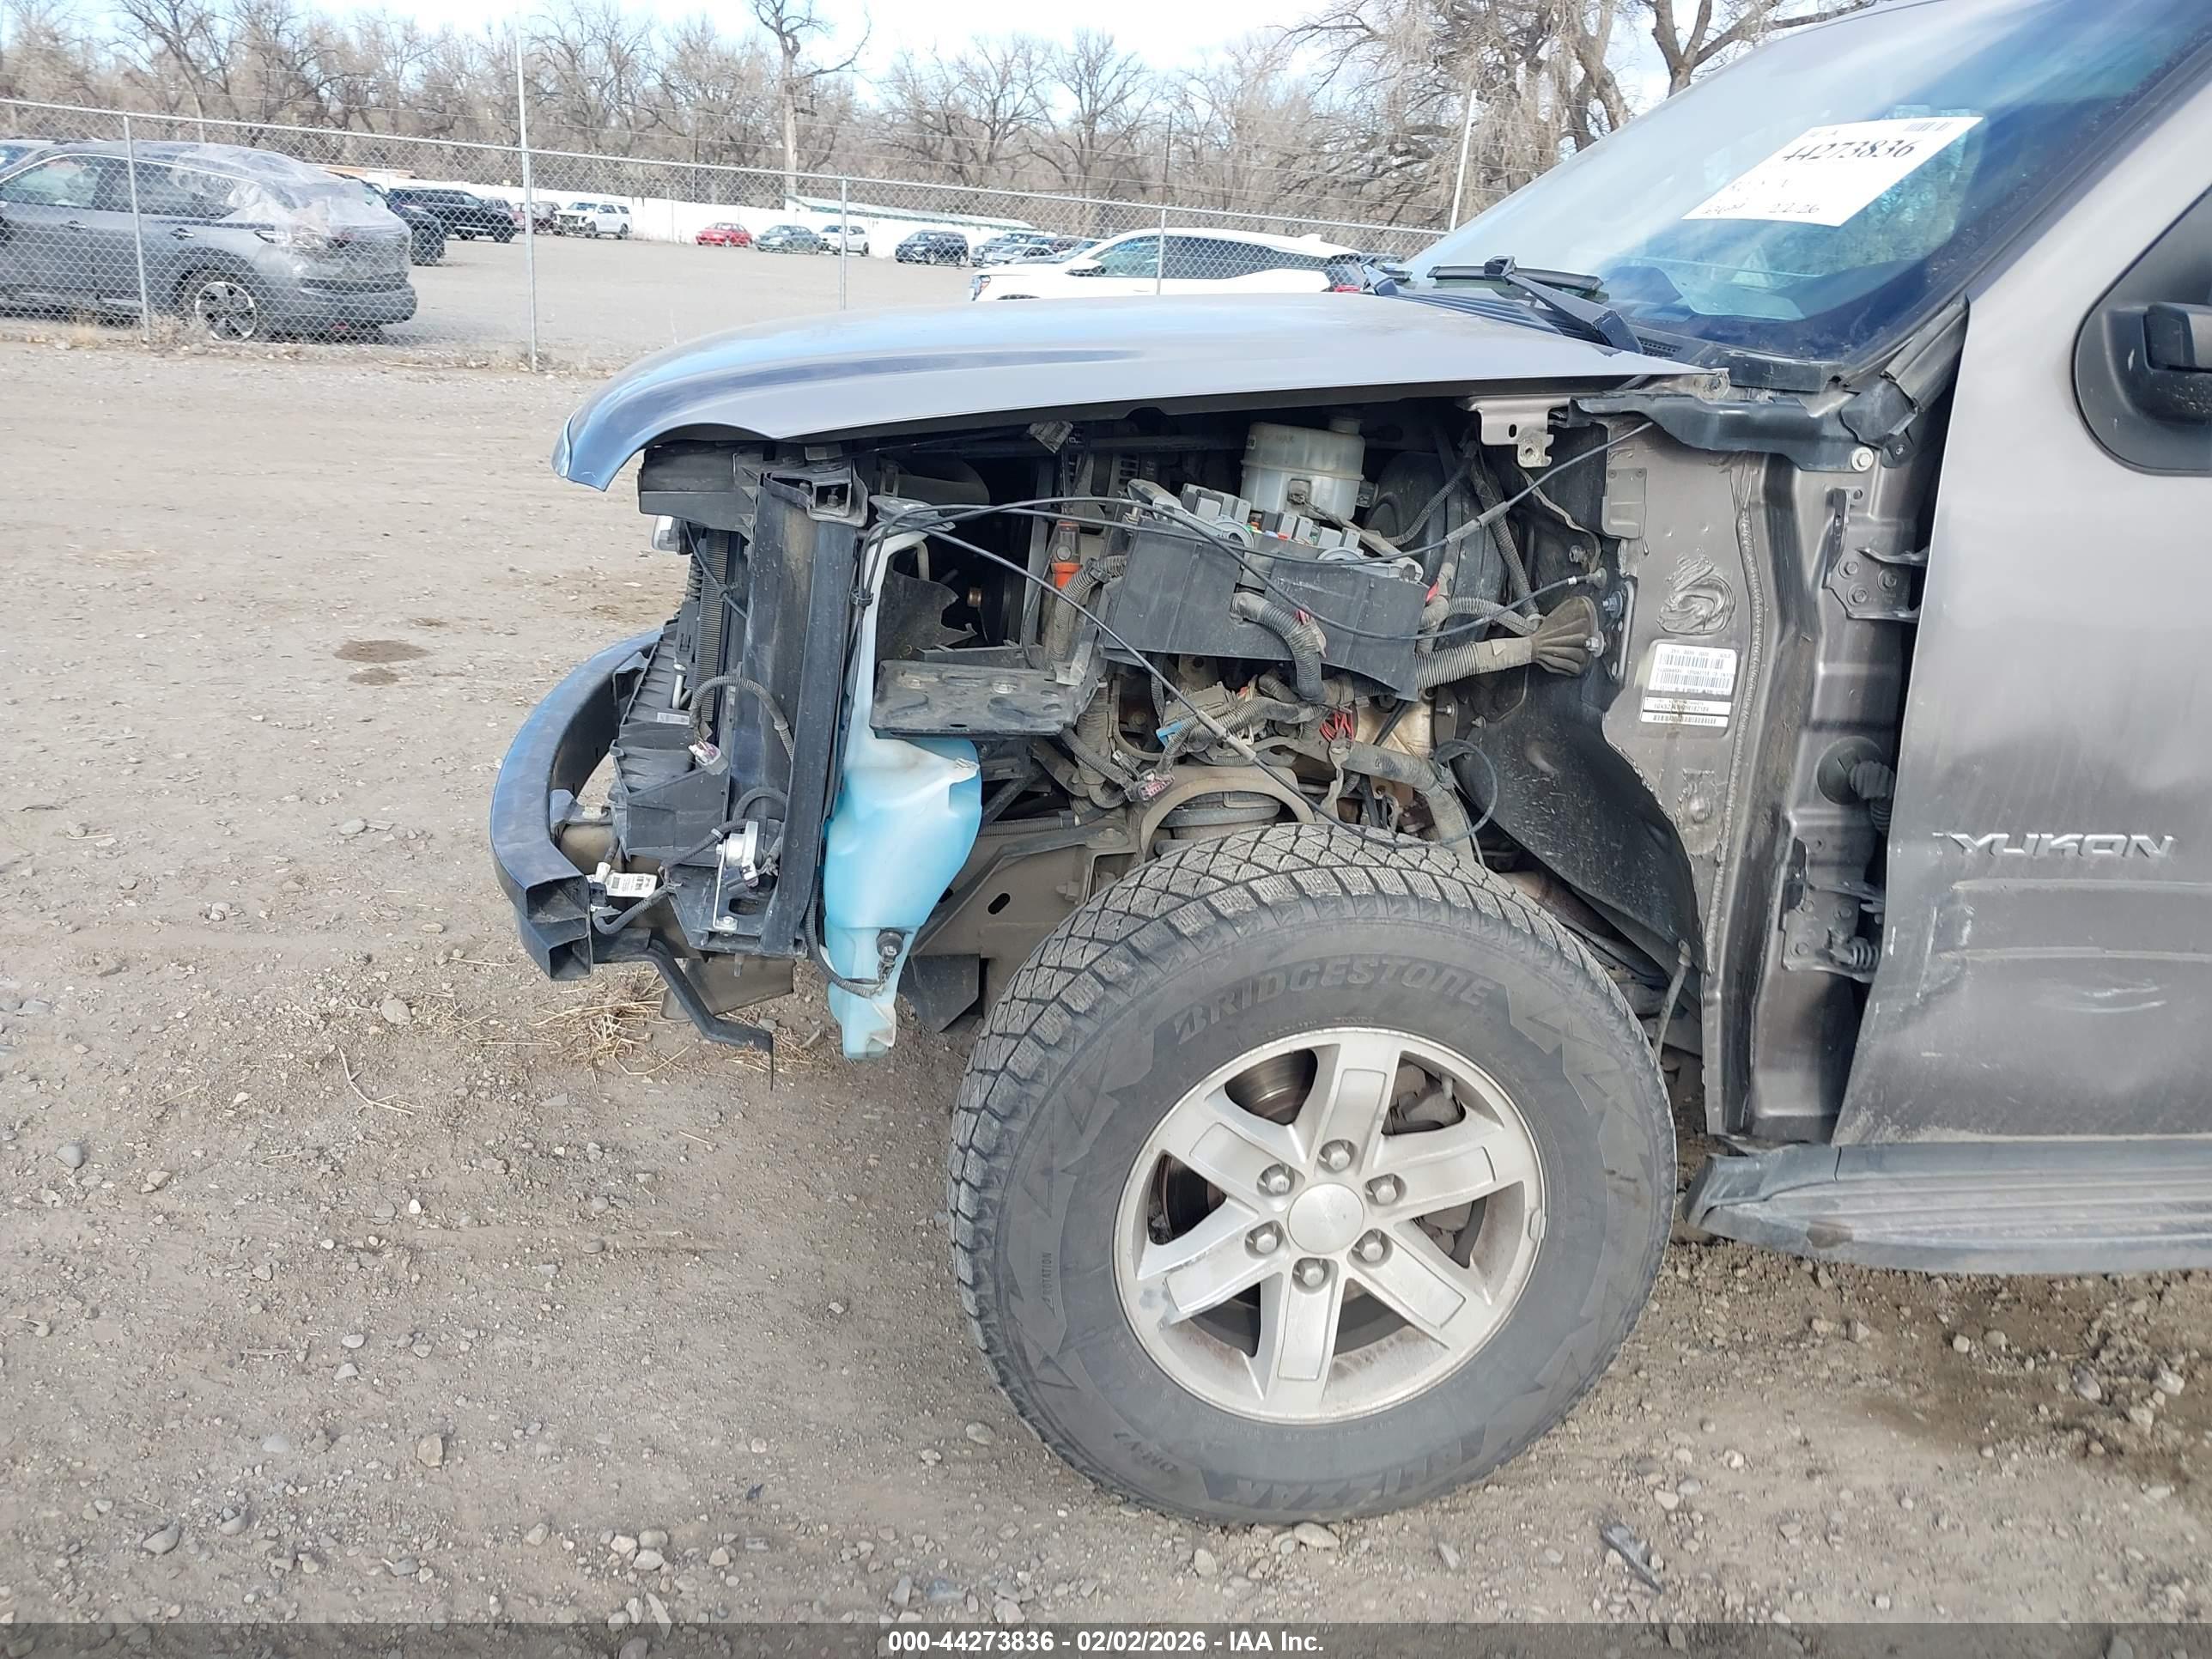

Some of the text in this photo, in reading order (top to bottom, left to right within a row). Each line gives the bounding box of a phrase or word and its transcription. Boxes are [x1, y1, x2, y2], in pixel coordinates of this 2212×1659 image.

[1780, 138, 1922, 161] 44273836
[1934, 831, 2174, 858] YUKON
[1174, 958, 1495, 1045] BRIDGESTONE
[1041, 1251, 1052, 1296] ROTATION
